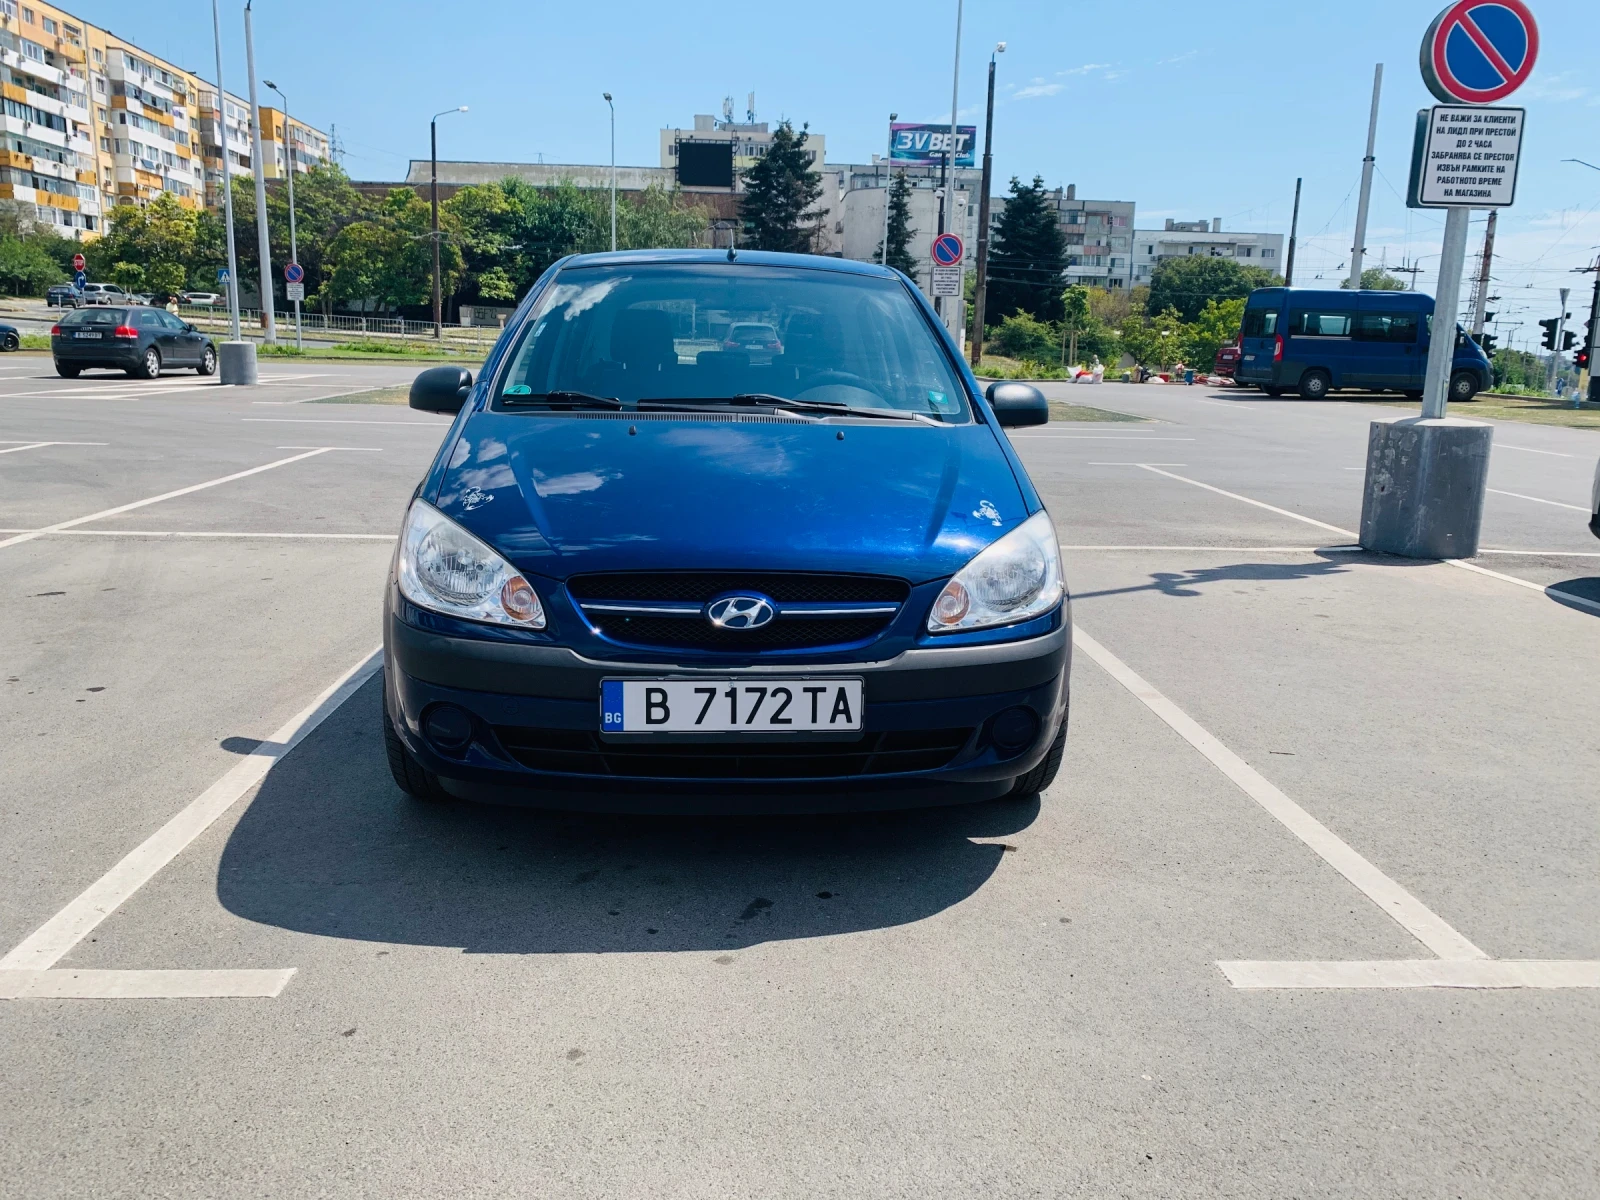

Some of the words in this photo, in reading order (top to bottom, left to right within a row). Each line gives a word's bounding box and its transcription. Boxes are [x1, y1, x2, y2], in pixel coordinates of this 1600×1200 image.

[1440, 114, 1449, 122] НЕ
[1450, 114, 1472, 122] ВАЖИ
[1473, 115, 1482, 123] ЗА
[1483, 115, 1516, 124] КЛИЕНТИ
[1436, 126, 1445, 134] НА
[1447, 127, 1468, 135] ЛИДЛ
[1469, 127, 1484, 135] ПРИ
[1485, 127, 1516, 136] ПРЕСТОЙ
[1456, 140, 1466, 148] ДО
[1468, 140, 1473, 148] 2
[1474, 140, 1492, 148] ЧАСА
[1431, 151, 1471, 160] ЗАБРАНЯВА
[1473, 152, 1482, 160] СЕ
[1437, 164, 1460, 172] ИЗВЪН
[1462, 165, 1495, 173] РАМКИТЕ
[1496, 165, 1505, 173] НА
[1436, 176, 1476, 184] РАБОТНОТО
[1478, 177, 1502, 185] ВРЕМЕ
[1444, 188, 1453, 196] НА
[1455, 189, 1491, 197] МАГАЗИНА
[645, 687, 670, 725] B
[694, 687, 793, 725] 7172
[802, 686, 853, 724] TA
[604, 712, 622, 724] BG
